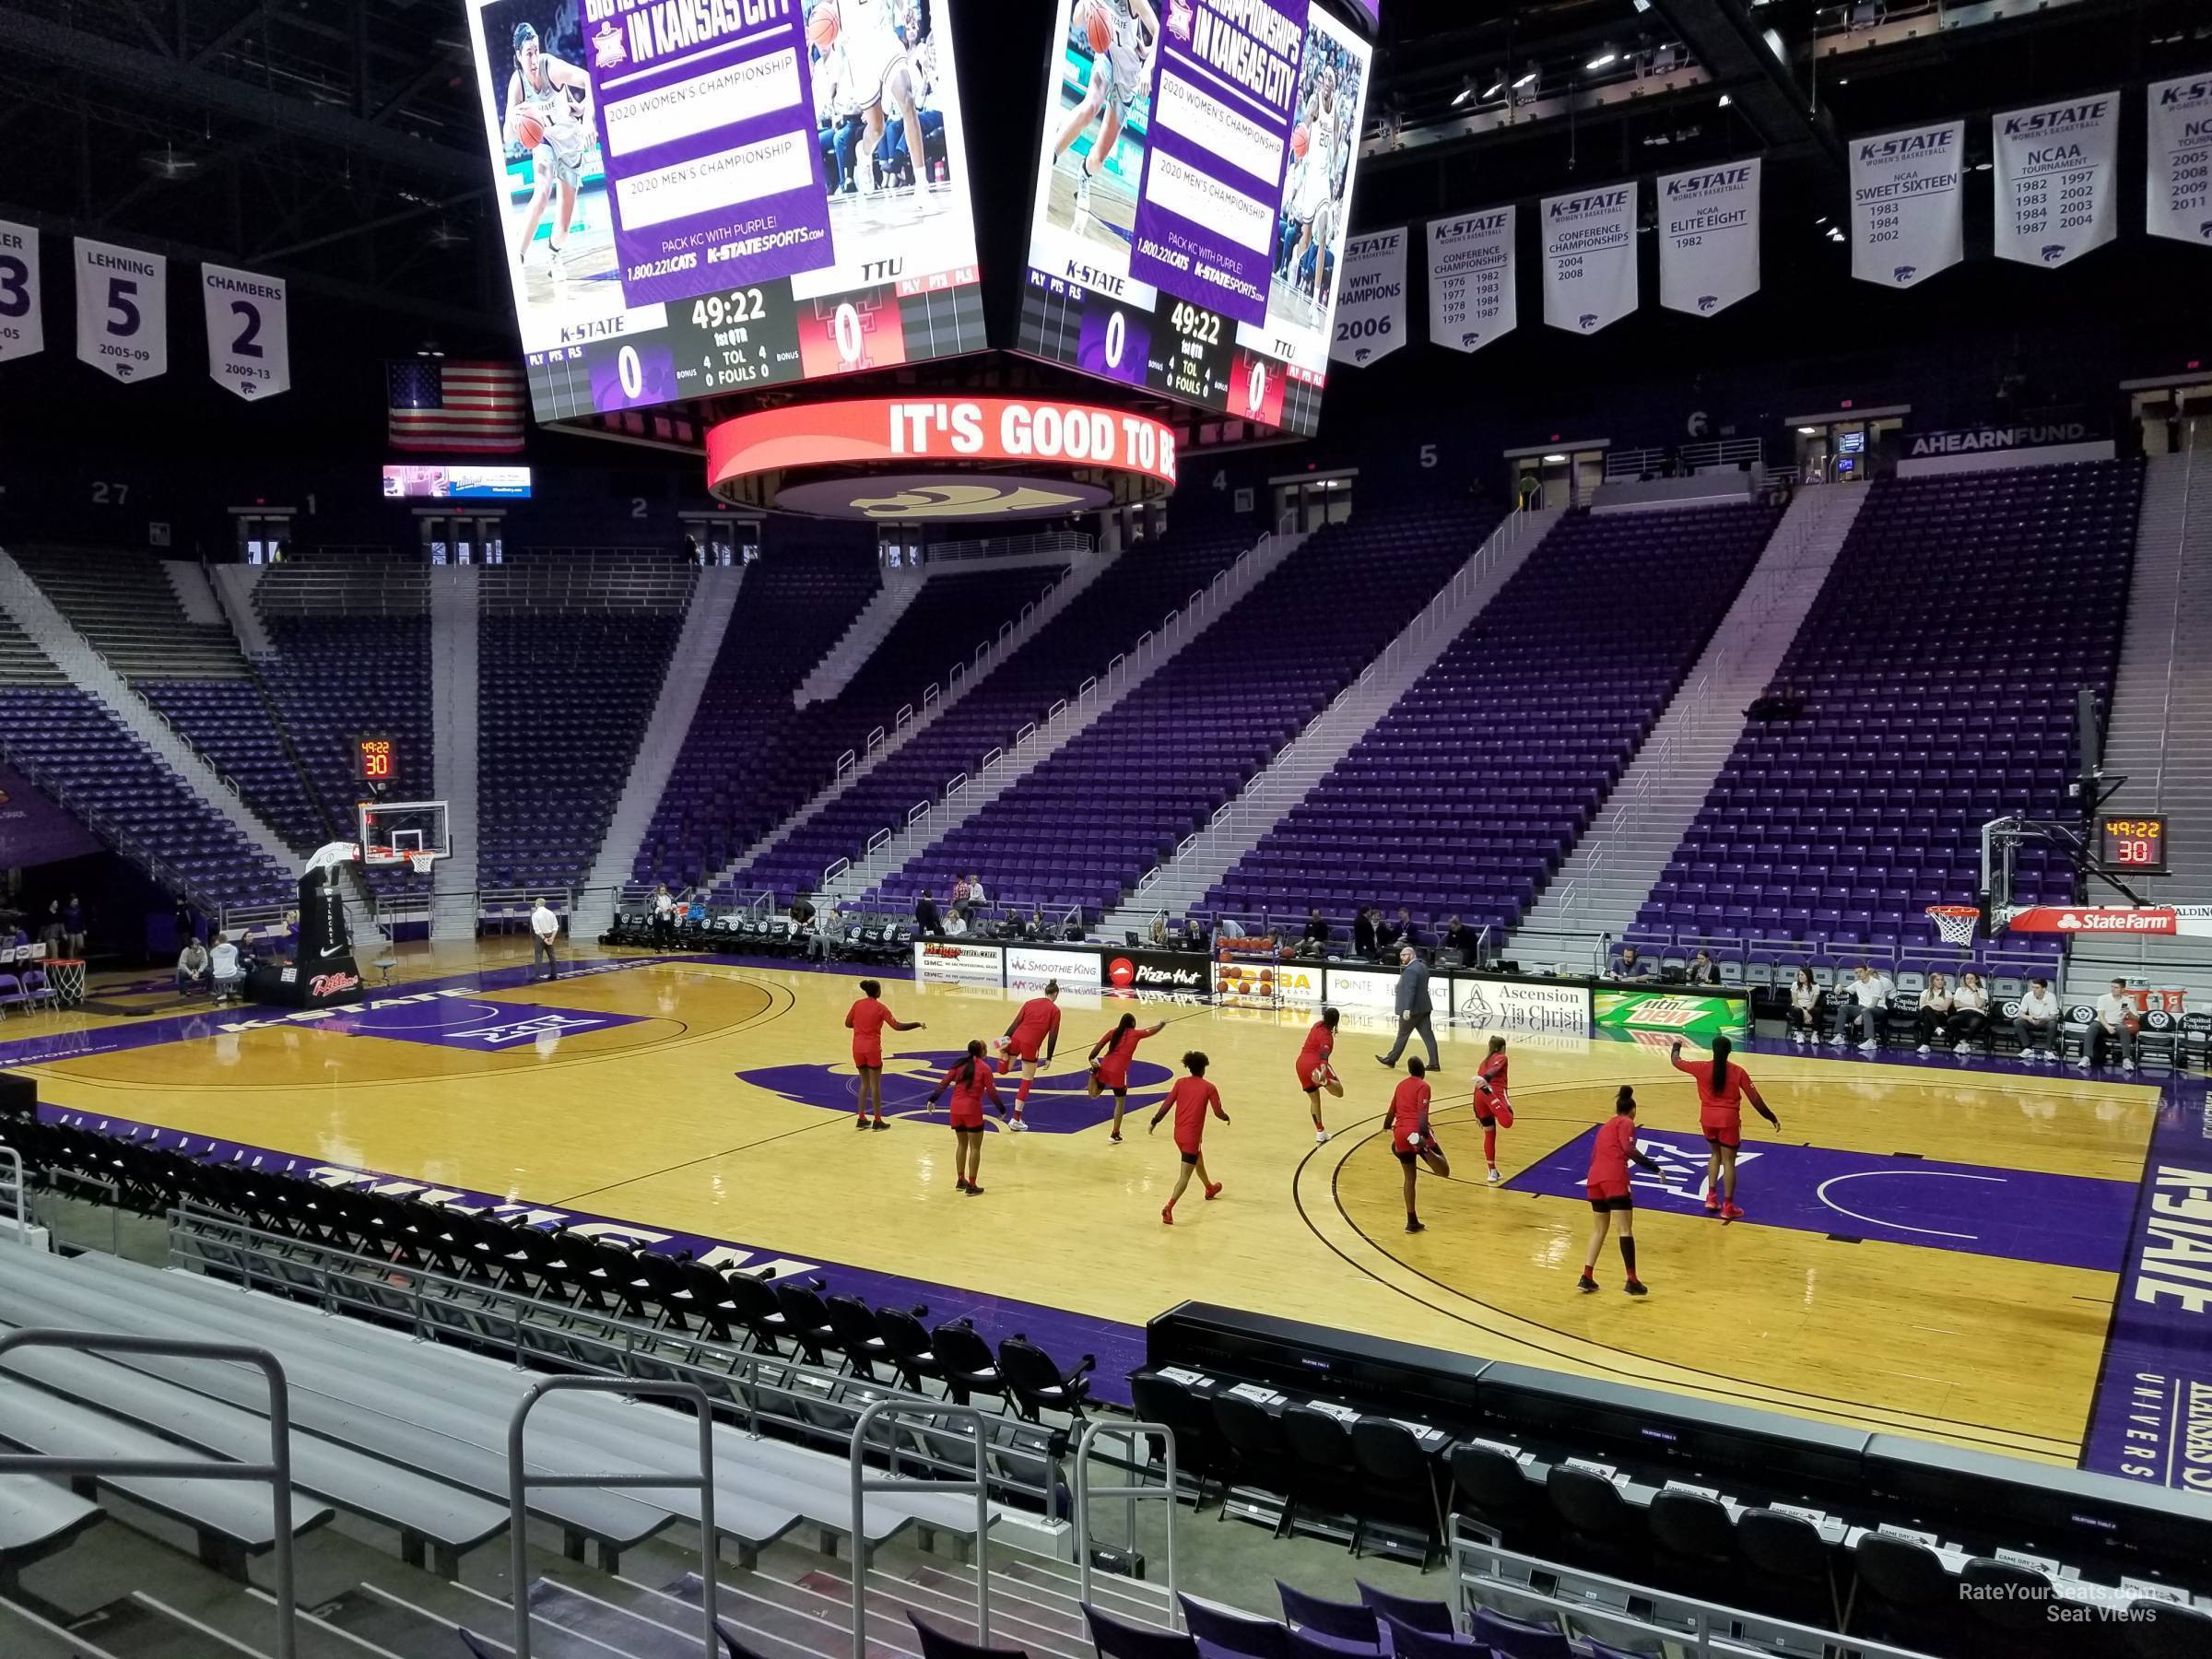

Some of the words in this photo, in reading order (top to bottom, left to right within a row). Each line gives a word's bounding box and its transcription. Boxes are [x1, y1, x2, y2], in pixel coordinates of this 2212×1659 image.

[627, 9, 654, 64] IN
[1192, 4, 1213, 60] IN
[1209, 16, 1268, 95] KANSAS
[1264, 53, 1296, 112] CITY
[609, 104, 637, 123] 2020
[641, 87, 696, 113] WOMEN'S
[699, 55, 793, 96] CHAMPIONSHIP
[1163, 77, 1184, 100] 2020
[1186, 92, 1224, 123] WOMEN'S
[1226, 114, 1281, 153] CHAMPIONSHIP
[2004, 101, 2108, 135] K-STATE
[2011, 128, 2049, 142] WOMEN'S
[2049, 120, 2100, 135] BASKETBALL
[1860, 129, 1955, 161] K-STATE
[2028, 144, 2081, 165] NCAA
[1865, 156, 1900, 167] WOMEN'S
[1900, 147, 1947, 162] BASKETBALL
[2021, 157, 2088, 175] TOURNAMENT
[2172, 151, 2208, 167] 2005
[630, 180, 658, 195] 2020
[662, 167, 697, 186] MEN'S
[700, 141, 793, 177] CHAMPIONSHIP
[1893, 171, 1919, 182] NCAA
[2171, 166, 2208, 182] 2008
[1160, 159, 1182, 179] 2020
[1183, 171, 1207, 193] MEN'S
[1208, 184, 1265, 219] CHAMPIONSHIP
[1666, 168, 1749, 196] K-STATE
[1854, 182, 1900, 202] SWEET
[1901, 172, 1958, 194] SIXTEEN
[2016, 179, 2048, 193] 1982
[2060, 171, 2094, 185] 1997
[2171, 181, 2207, 197] 2009
[1549, 190, 1629, 218] K-STATE
[2016, 193, 2048, 207] 1983
[2060, 186, 2094, 200] 2002
[2171, 196, 2206, 211] 2011
[1583, 205, 1623, 218] BASKETBALL
[1696, 206, 1719, 217] NCAA
[1869, 203, 1900, 215] 1983
[2016, 207, 2048, 221] 1984
[2060, 200, 2094, 215] 2003
[1435, 213, 1508, 241] K-STATE
[1670, 217, 1705, 234] ELITE
[1707, 209, 1747, 229] EIGHT
[1869, 217, 1900, 229] 1984
[2016, 221, 2048, 236] 1987
[2060, 215, 2094, 229] 2004
[662, 238, 689, 253] PACK
[690, 233, 704, 247] KC
[706, 229, 733, 244] WITH
[734, 216, 778, 239] PURPLE!
[1466, 229, 1503, 241] BASKETBALL
[1548, 231, 1630, 254] CHAMPIONSHIPS
[1558, 224, 1621, 242] CONFERENCE
[1675, 236, 1703, 249] 1982
[1868, 230, 1900, 243] 2002
[1169, 231, 1188, 250] PACK
[1188, 241, 1198, 255] KC
[1198, 245, 1217, 263] WITH
[1216, 253, 1243, 275] PURPLE!
[1442, 245, 1500, 264] CONFERENCE
[1558, 256, 1583, 269] 2004
[88, 251, 156, 278] LEHNING
[861, 256, 903, 282] TTU
[1434, 253, 1508, 275] CHAMPIONSHIPS
[1558, 268, 1583, 281] 2008
[206, 275, 283, 301] CHAMBERS
[1065, 259, 1125, 297] K-STATE
[1348, 272, 1381, 288] WNIT
[1441, 277, 1466, 289] 1976
[1476, 270, 1500, 282] 1982
[1336, 282, 1401, 307] HAMPIONS
[1441, 289, 1466, 301] 1977
[1476, 283, 1500, 294] 1983
[106, 276, 142, 338] 5
[691, 288, 766, 330] 49:22
[1441, 300, 1466, 312] 1978
[1476, 295, 1500, 306] 1984
[1171, 301, 1220, 346] 49:22
[1441, 313, 1466, 324] 1979
[1476, 307, 1500, 319] 1987
[230, 300, 264, 359] 2
[560, 315, 626, 344] K-STATE
[834, 302, 863, 362] 0
[1336, 315, 1392, 342] 2006
[1105, 311, 1125, 369] 0
[1274, 338, 1296, 359] TTU
[99, 343, 150, 363] 2005-09
[703, 355, 712, 369] 4
[723, 348, 747, 366] TOL
[759, 346, 767, 359] 4
[776, 349, 800, 362] BONUS
[225, 362, 272, 381] 2009-13
[618, 345, 642, 399] 0
[676, 368, 698, 380] BONUS
[705, 372, 714, 387] 0
[718, 366, 758, 386] FOULS
[760, 363, 770, 378] 0
[1183, 360, 1197, 377] TOL
[1175, 377, 1201, 395] FOULS
[1202, 385, 1209, 398] 0
[1249, 361, 1265, 413] 0
[889, 403, 984, 456] IT'S
[1000, 406, 1115, 461] GOOD
[1122, 418, 1155, 469] TO
[1419, 443, 1438, 469] 5
[1212, 469, 1227, 491] 4
[91, 480, 130, 505] 27
[631, 498, 648, 518] 2
[361, 741, 390, 754] 49:22
[366, 754, 388, 775] 30
[2106, 821, 2160, 838] 49:22
[2118, 841, 2148, 863] 30
[326, 897, 335, 946] WILDCATS
[1028, 960, 1073, 974] SMOOTHIE
[1135, 965, 1173, 982] Pizza
[1172, 968, 1202, 985] Hut
[1499, 984, 1580, 1004] Ascension
[1894, 996, 1919, 1006] Capitol
[218, 986, 482, 1034] K-STATE
[1499, 1003, 1524, 1018] Via
[1529, 1005, 1583, 1022] Christi
[1893, 1002, 1918, 1012] Federal
